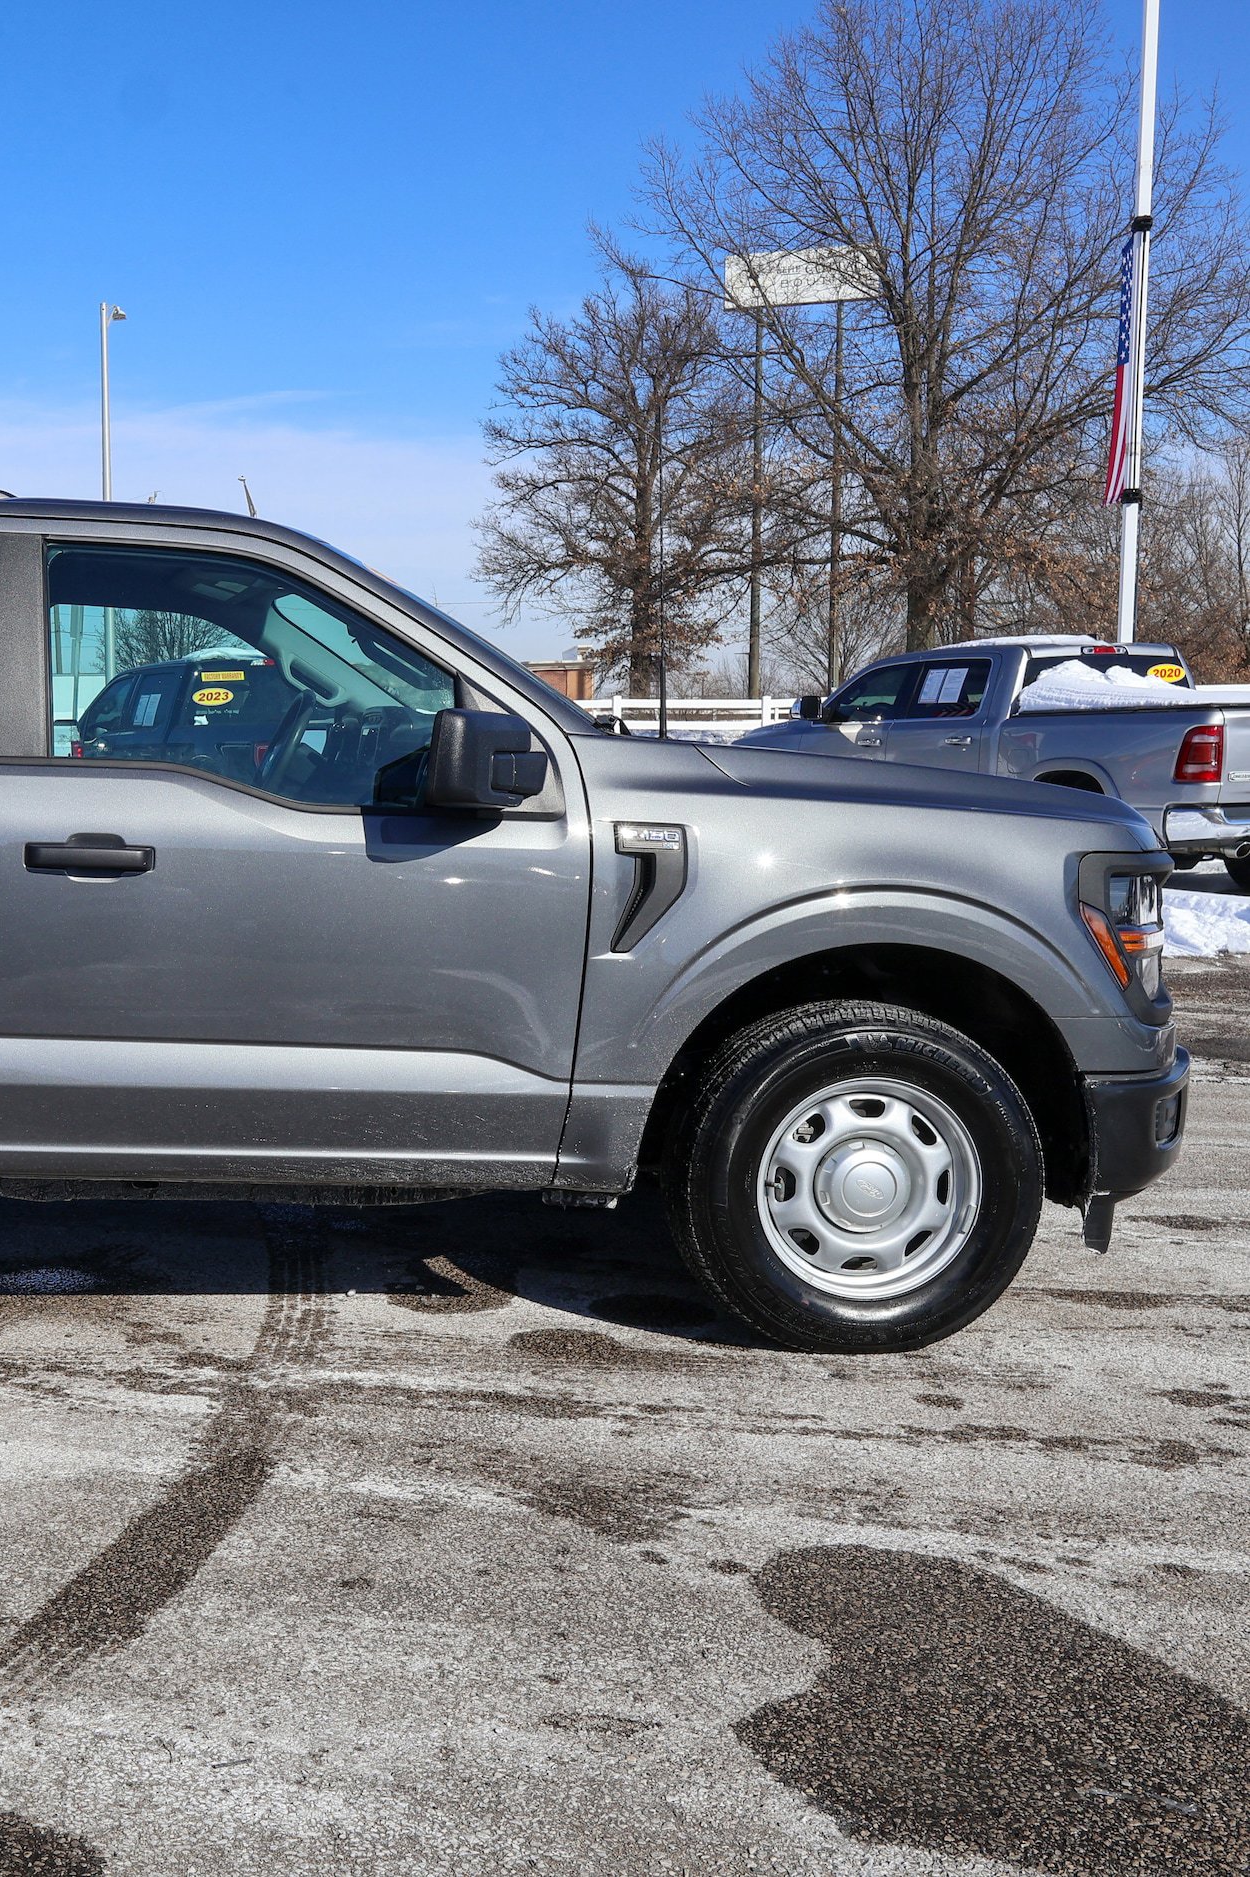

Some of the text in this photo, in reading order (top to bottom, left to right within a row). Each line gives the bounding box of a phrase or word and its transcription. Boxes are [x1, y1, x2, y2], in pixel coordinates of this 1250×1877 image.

[1152, 668, 1181, 678] 2020
[198, 691, 229, 702] 2023
[895, 1037, 992, 1093] MICHELIN
